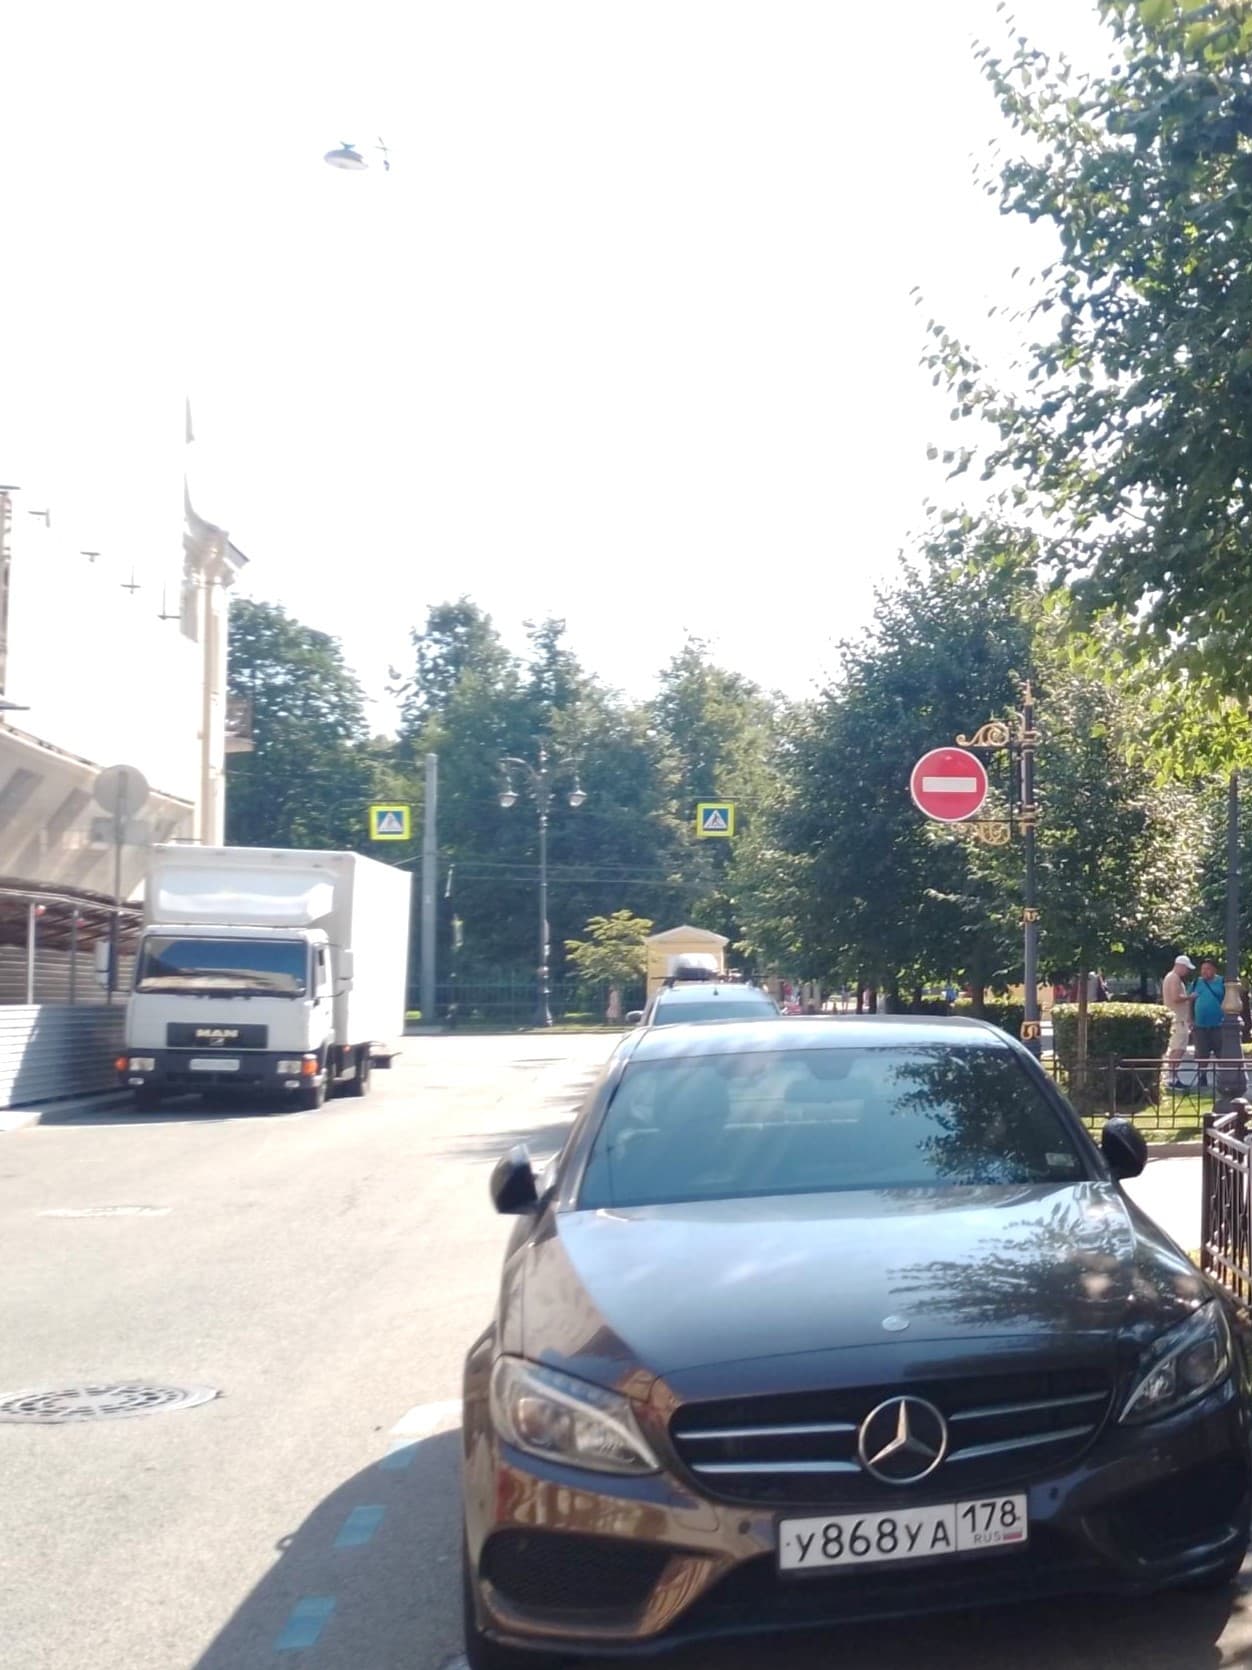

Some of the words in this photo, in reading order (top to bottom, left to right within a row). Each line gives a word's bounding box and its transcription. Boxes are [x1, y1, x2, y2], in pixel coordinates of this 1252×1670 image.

[196, 1029, 239, 1038] MAN
[962, 1499, 1017, 1533] 178
[974, 1531, 1002, 1544] RUS
